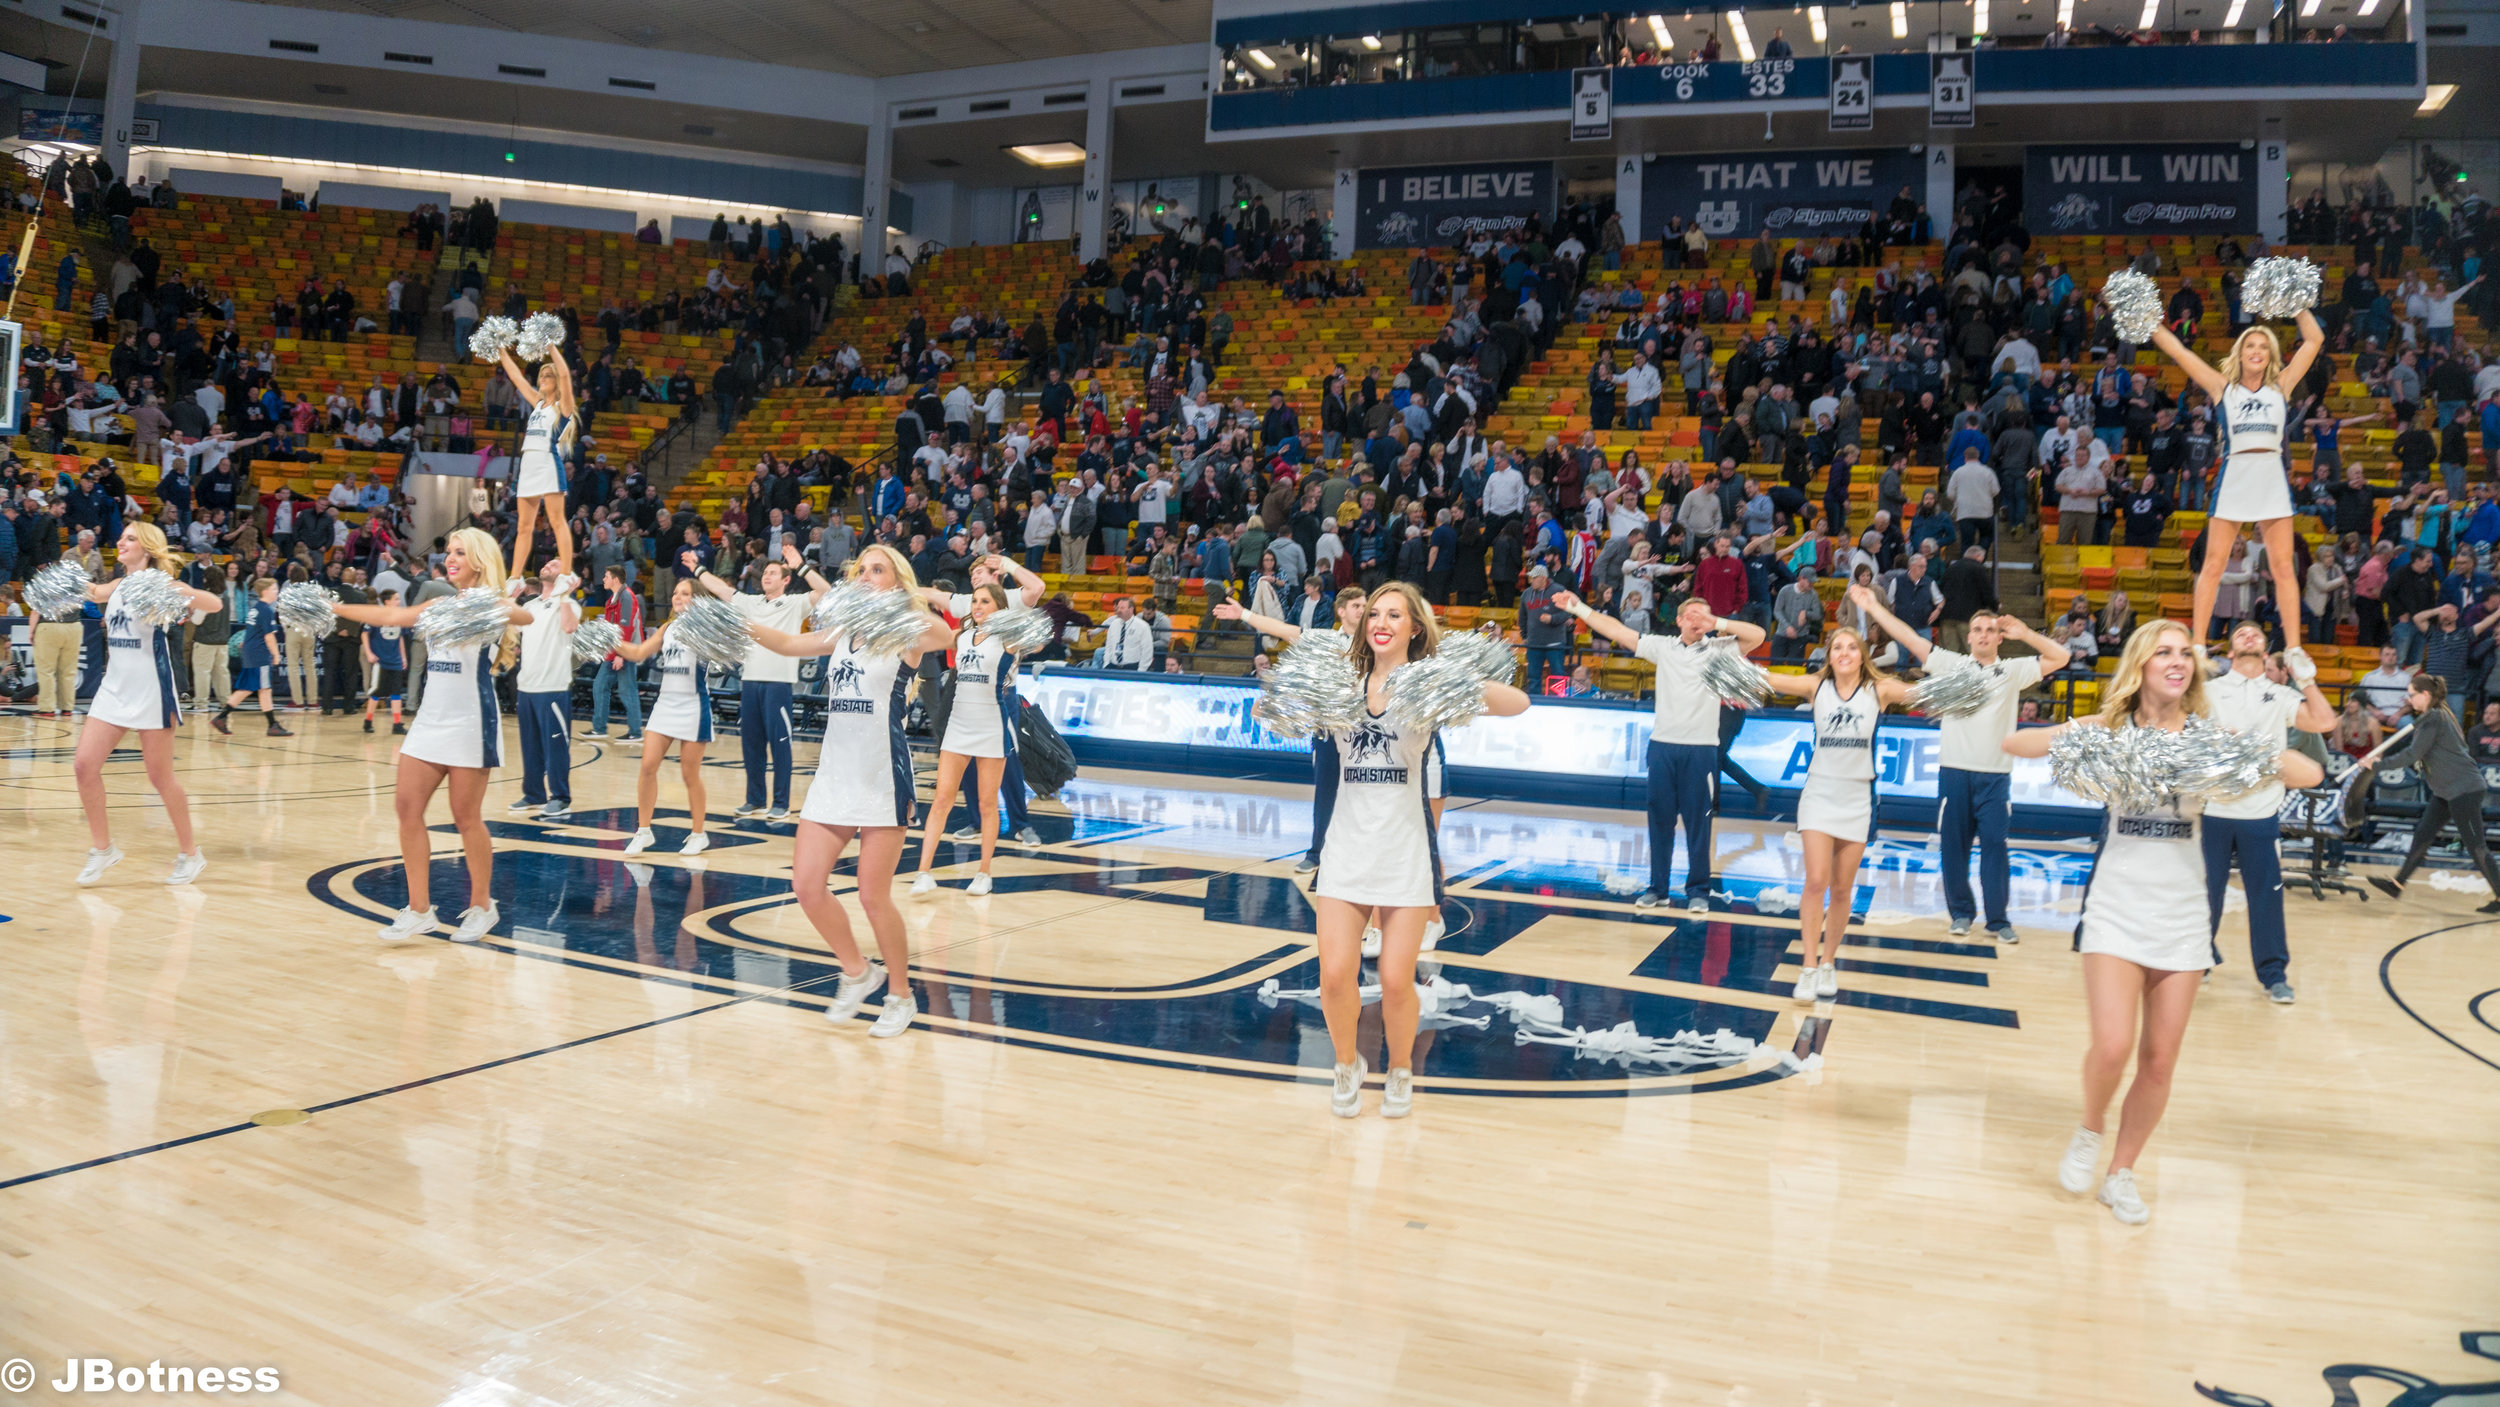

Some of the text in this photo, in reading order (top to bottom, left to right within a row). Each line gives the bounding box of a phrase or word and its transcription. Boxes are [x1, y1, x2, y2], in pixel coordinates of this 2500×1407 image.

[1661, 64, 1709, 79] COOK
[1741, 59, 1795, 75] ESTES
[1676, 77, 1694, 100] 6
[1750, 73, 1785, 97] 33
[1838, 89, 1865, 106] 24
[1940, 86, 1963, 102] 31
[1586, 101, 1597, 116] 5
[117, 129, 127, 143] U
[1934, 150, 1946, 165] A
[2267, 146, 2280, 161] B
[1623, 160, 1635, 174] A
[1697, 159, 1874, 191] THAT WE
[2050, 154, 2240, 183] WILL WIN
[1340, 172, 1350, 186] X
[1086, 189, 1099, 202] W
[1378, 172, 1534, 203] I BELIEVE
[867, 206, 874, 217] V
[1793, 207, 1871, 226] Sign Pro
[2154, 204, 2236, 223] Sign Pro
[435, 661, 461, 673] STATE
[842, 700, 874, 714] STATE
[1344, 767, 1408, 784] UTAH STATE
[2118, 817, 2193, 838] UTAH STATE
